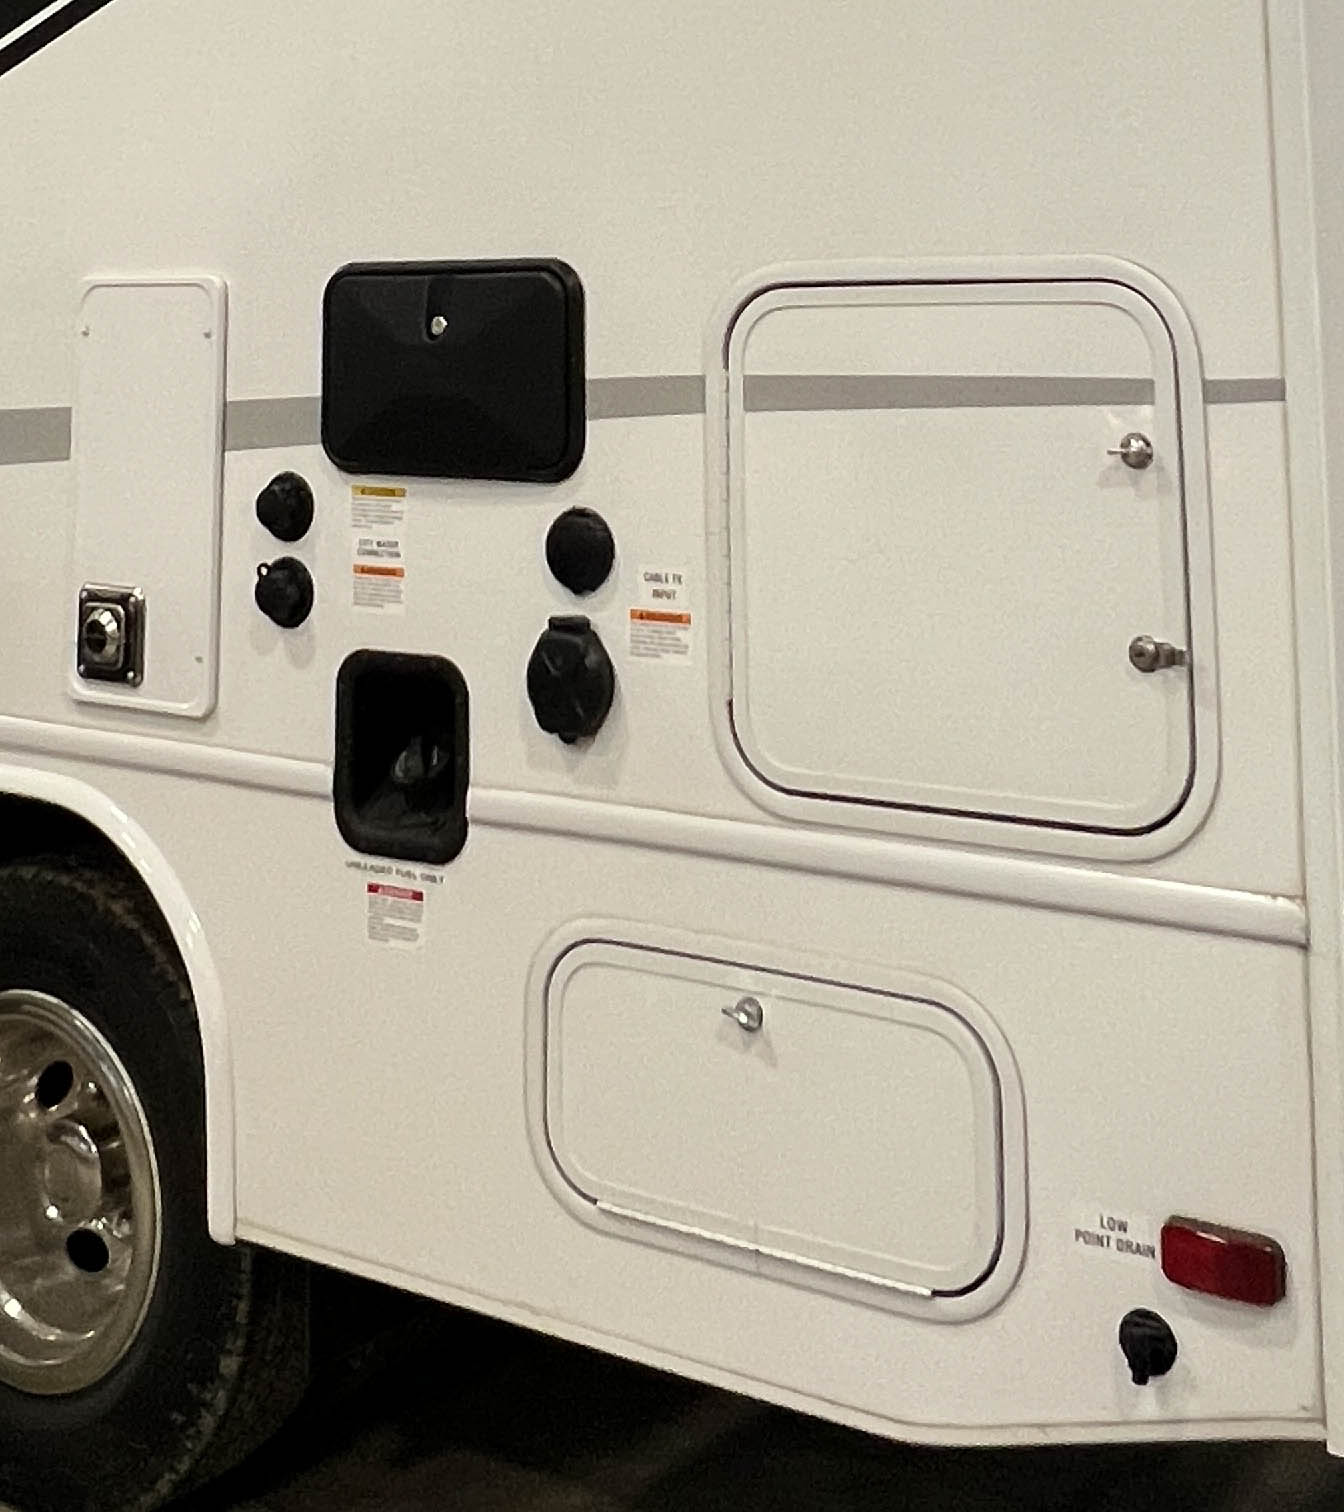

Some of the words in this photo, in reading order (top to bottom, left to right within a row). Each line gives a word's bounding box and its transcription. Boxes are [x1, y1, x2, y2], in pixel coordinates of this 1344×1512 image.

[1099, 1213, 1129, 1234] LOW
[1074, 1228, 1112, 1248] POINT
[1116, 1238, 1156, 1260] DRAIN
